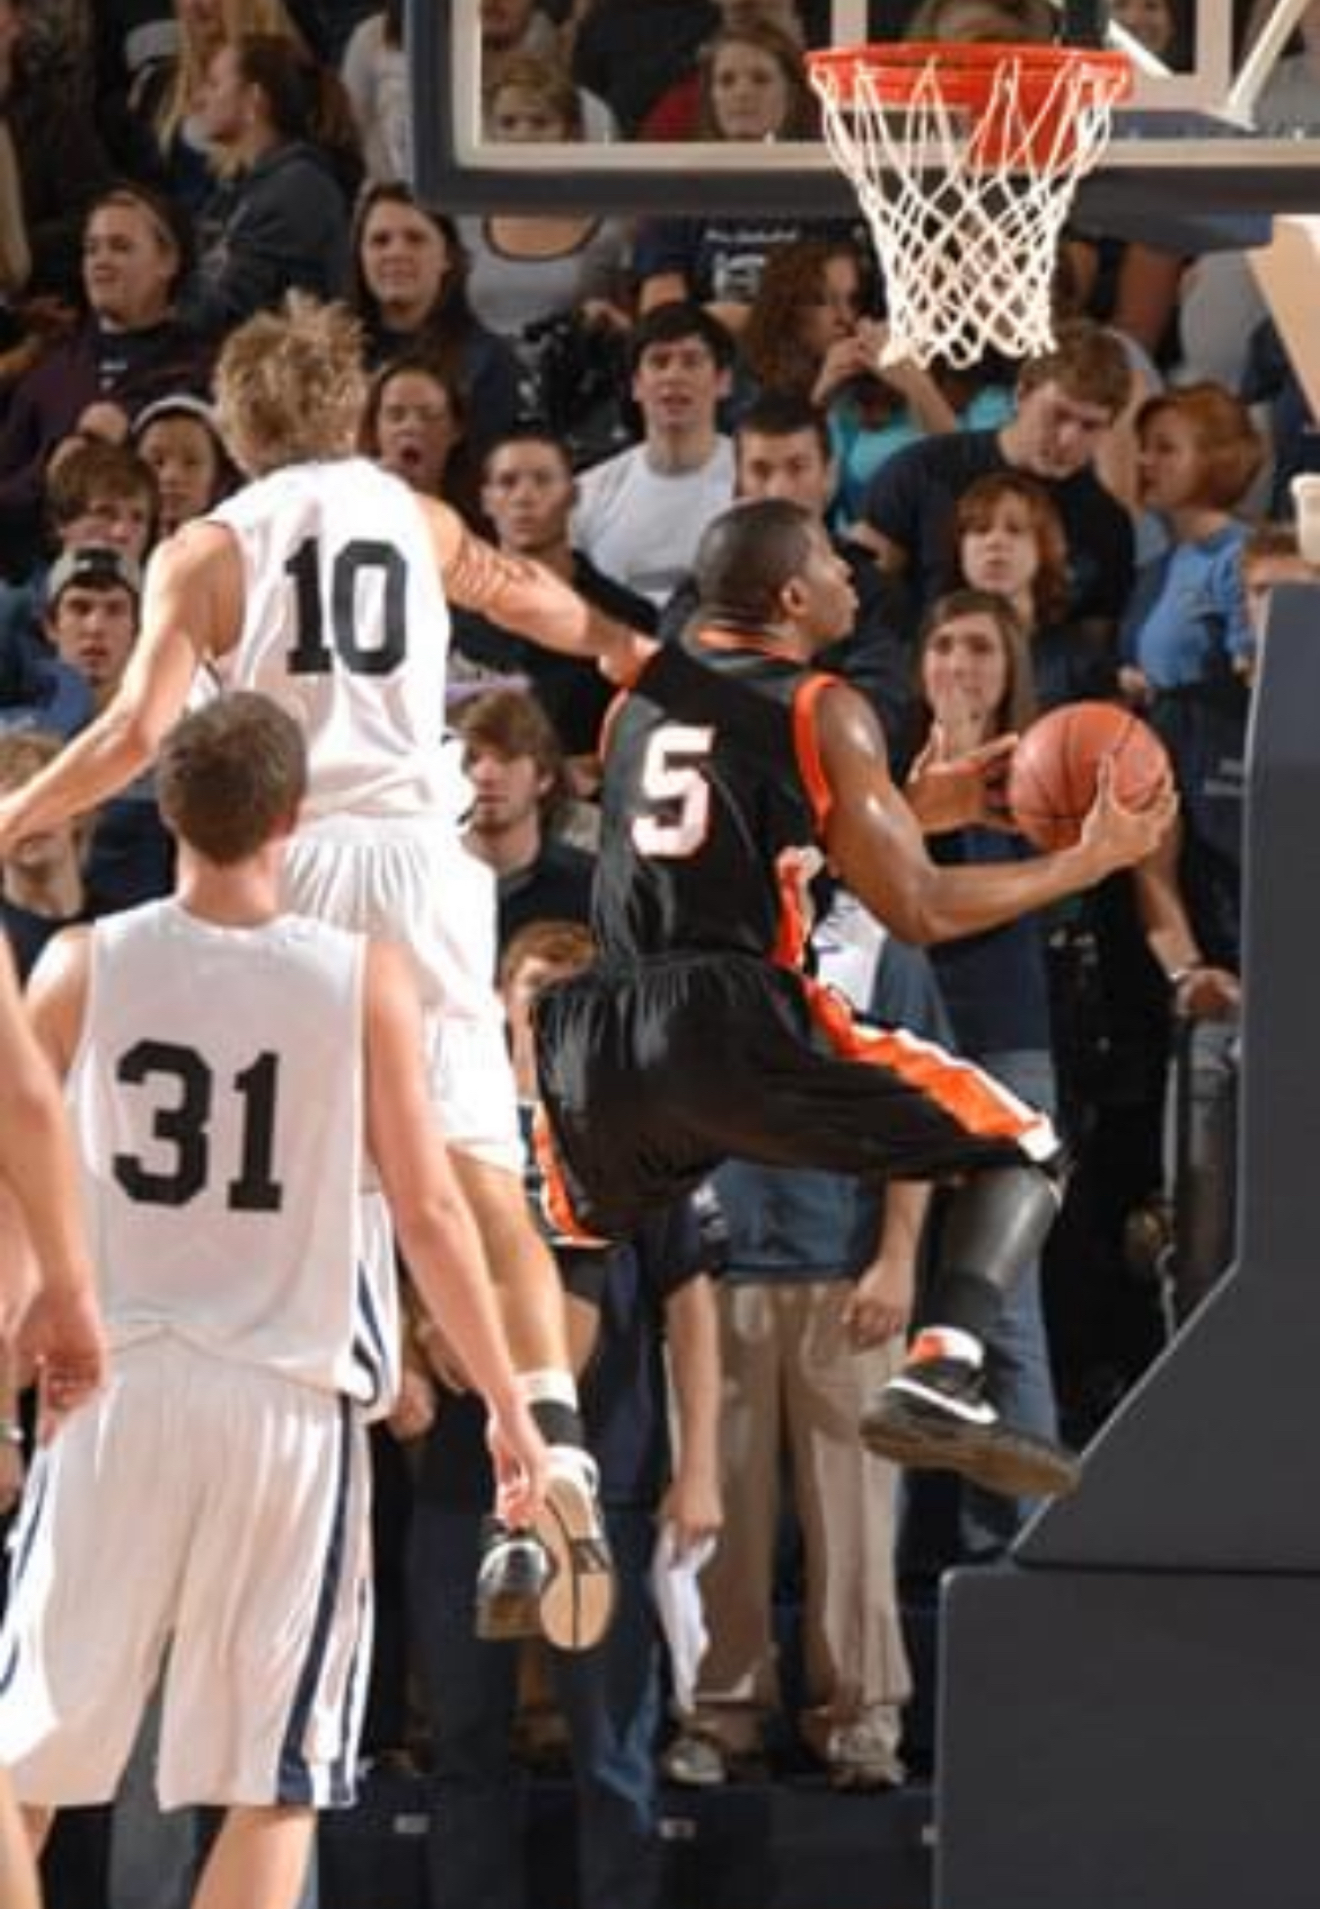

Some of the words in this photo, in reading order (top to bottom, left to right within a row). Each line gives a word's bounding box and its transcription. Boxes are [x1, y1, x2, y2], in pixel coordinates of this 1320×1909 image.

[284, 537, 407, 675] 10
[632, 725, 714, 857] 5
[113, 1038, 282, 1211] 31
